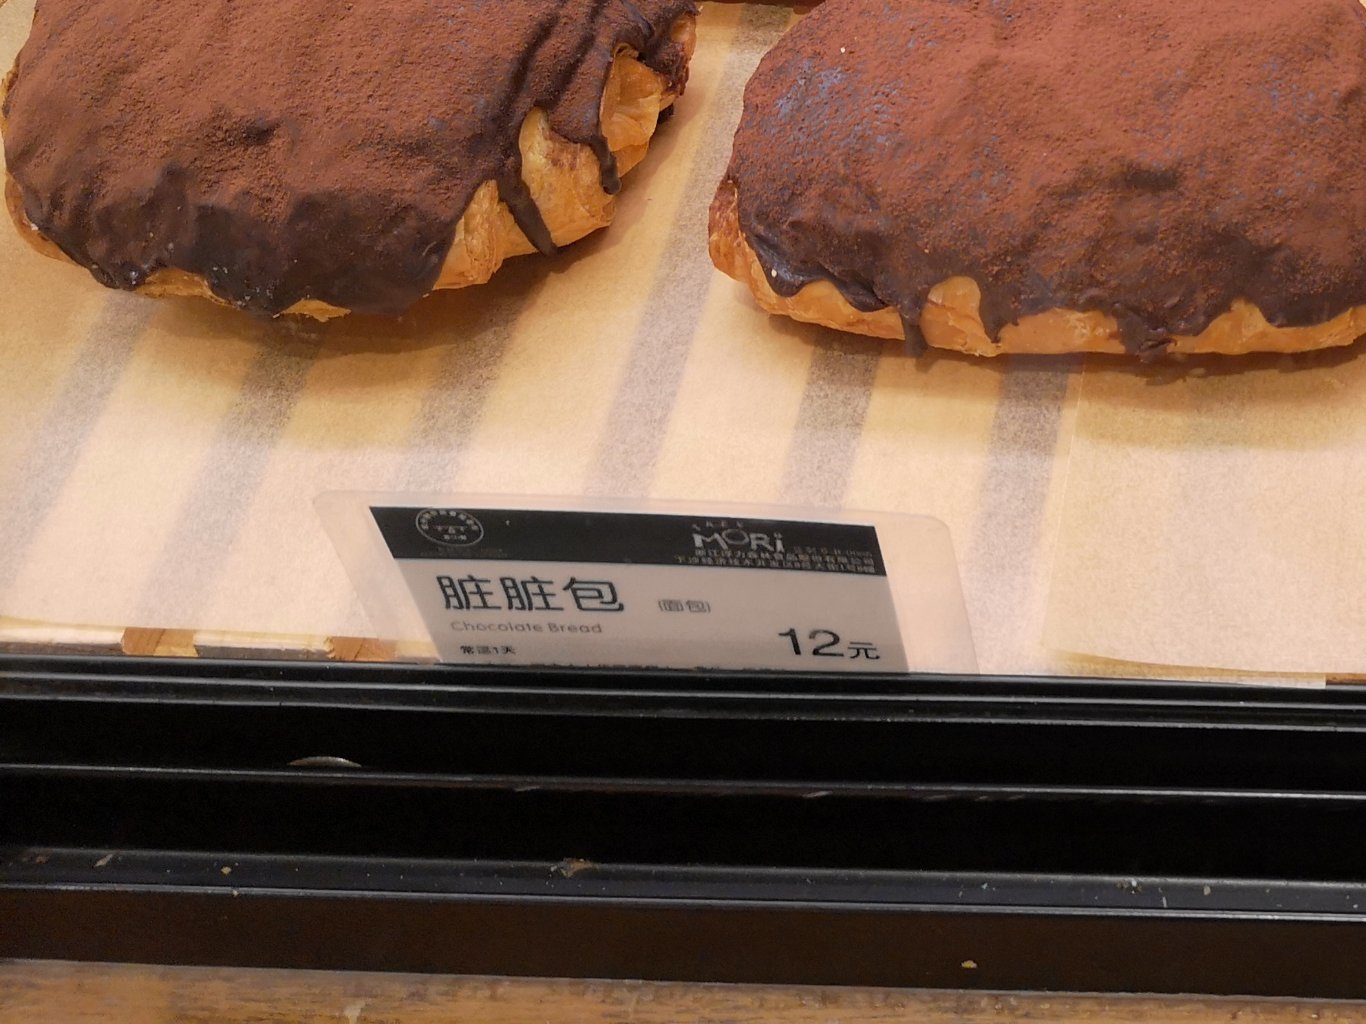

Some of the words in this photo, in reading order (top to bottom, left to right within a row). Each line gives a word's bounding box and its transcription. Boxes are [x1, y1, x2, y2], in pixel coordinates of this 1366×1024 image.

[436, 574, 625, 613] 脏脏包
[450, 621, 539, 633] Chocolate
[547, 622, 603, 634] Bread
